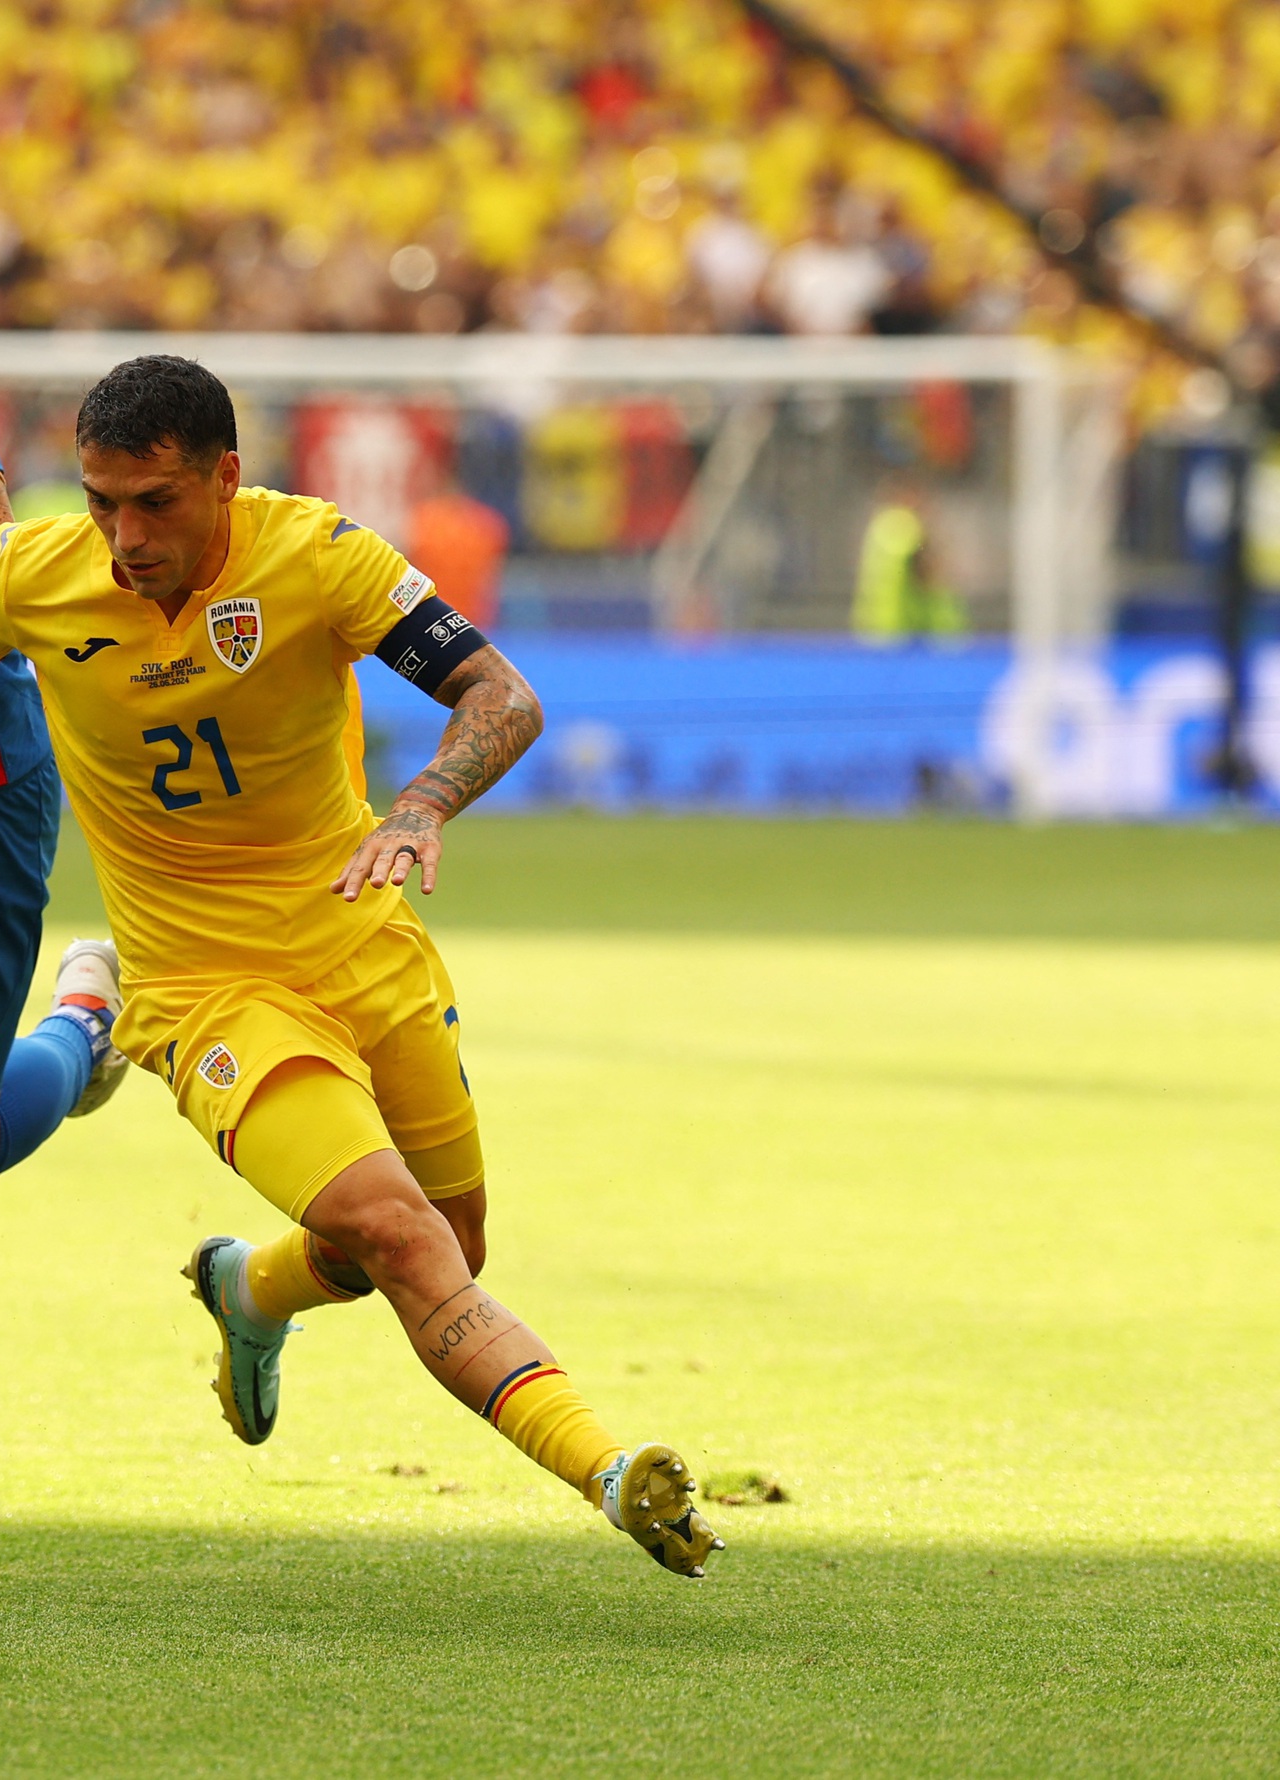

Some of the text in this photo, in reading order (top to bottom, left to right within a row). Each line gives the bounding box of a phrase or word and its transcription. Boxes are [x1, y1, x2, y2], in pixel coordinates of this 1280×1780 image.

[391, 584, 405, 600] UEFA
[211, 600, 256, 619] ROMÂNIA
[141, 663, 164, 674] SVK
[170, 657, 194, 671] ROU
[130, 666, 207, 683] FRANKFURT PE MAIN
[142, 716, 242, 811] 21
